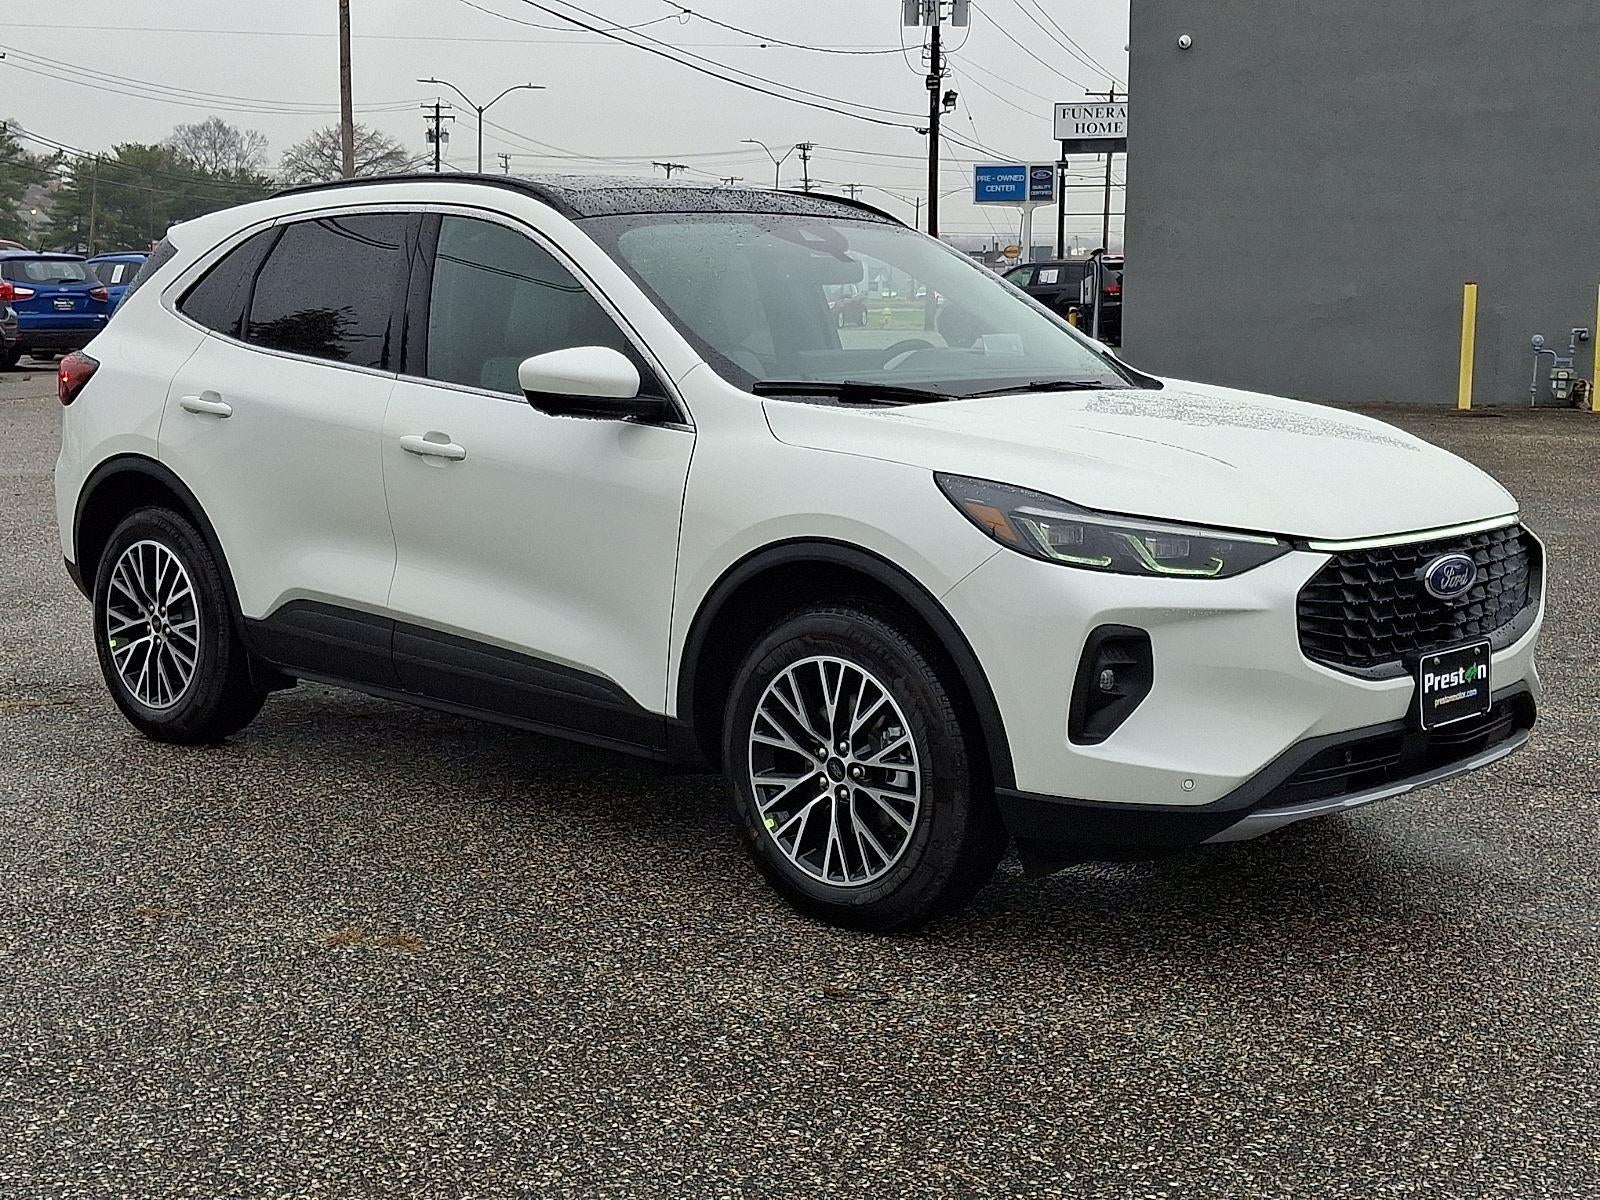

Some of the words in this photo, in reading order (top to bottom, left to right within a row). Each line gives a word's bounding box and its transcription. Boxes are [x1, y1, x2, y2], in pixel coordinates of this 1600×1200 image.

[1075, 121, 1124, 134] HOME
[985, 184, 1016, 192] CENTER
[1440, 564, 1469, 590] Ford
[1424, 662, 1487, 694] Prestn
